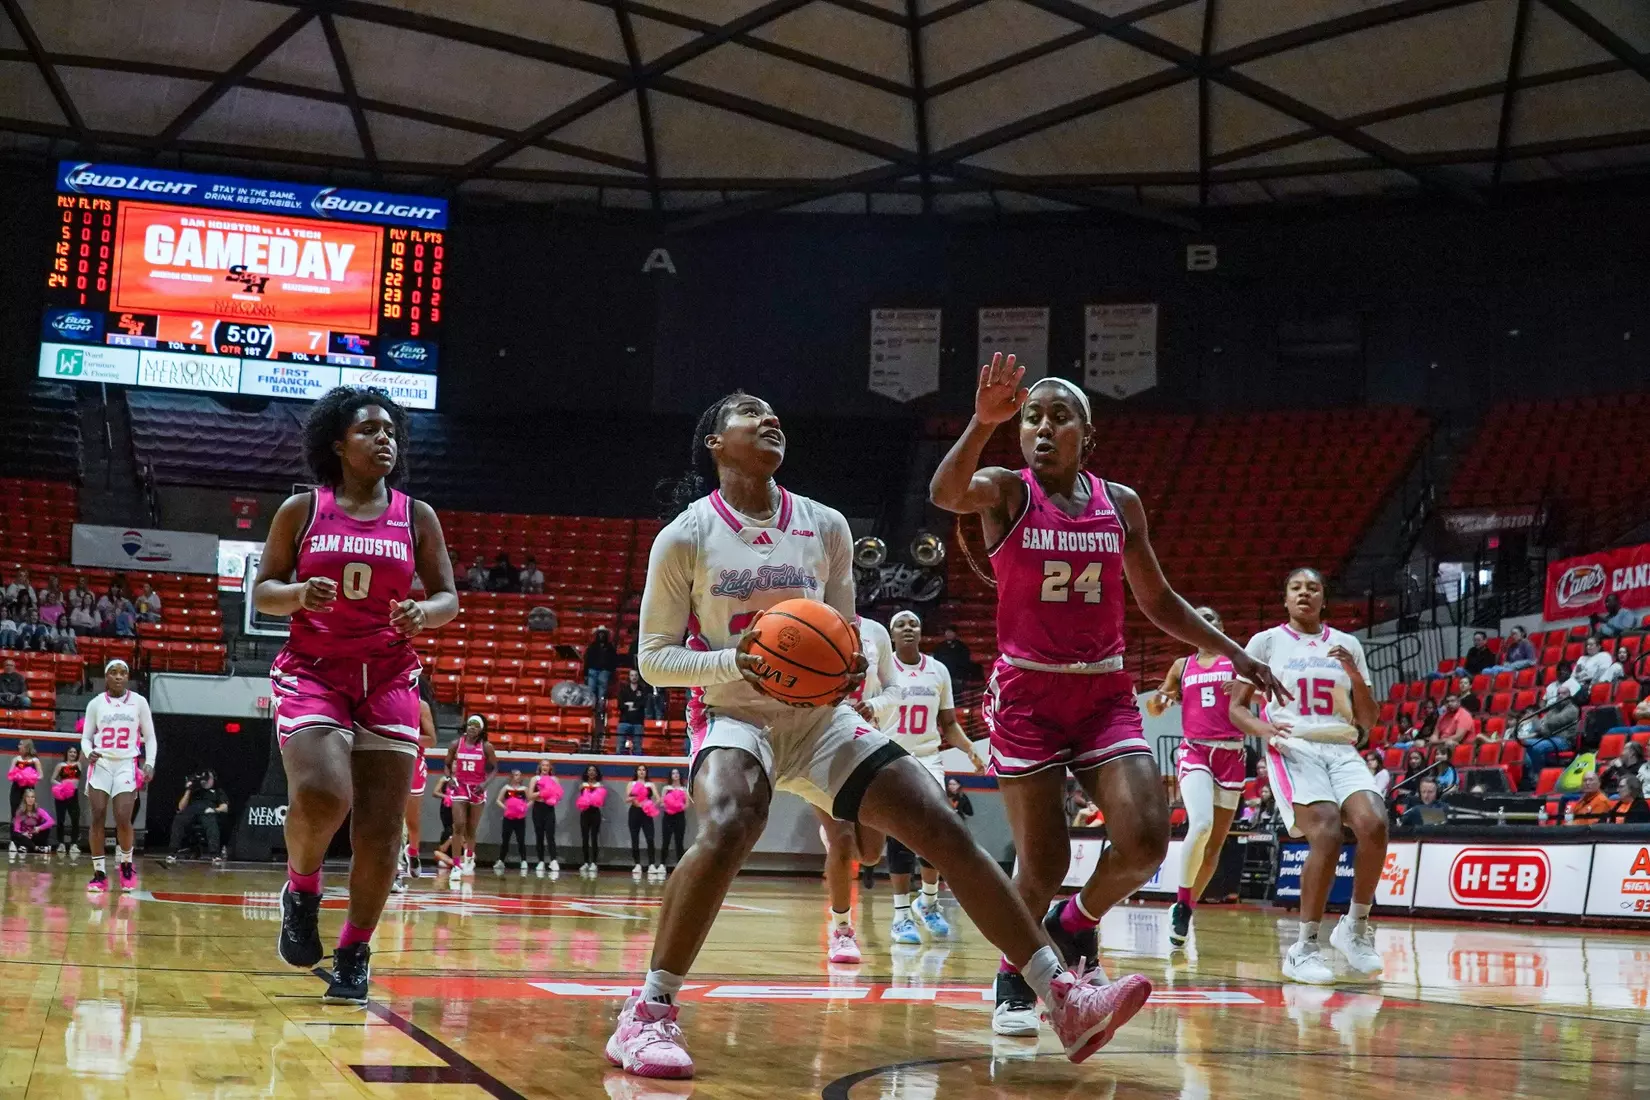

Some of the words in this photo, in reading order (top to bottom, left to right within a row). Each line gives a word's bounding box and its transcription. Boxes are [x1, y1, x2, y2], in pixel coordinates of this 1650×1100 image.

[75, 172, 127, 188] BUD
[126, 176, 197, 194] LIGHT
[204, 192, 234, 202] DRINK
[236, 195, 302, 208] RESPONSIBLY.
[213, 184, 236, 193] STAY
[250, 189, 268, 197] THE
[269, 190, 296, 200] GAME.
[58, 196, 75, 207] PLY
[79, 198, 90, 209] FL
[93, 199, 111, 211] PTS
[322, 196, 372, 213] BUD
[371, 201, 441, 219] LIGHT
[63, 211, 72, 223] 0
[83, 212, 92, 224] 0
[103, 214, 111, 226] 0
[81, 228, 90, 240] 0
[101, 230, 110, 242] 0
[208, 220, 260, 233] HOUSTON
[276, 227, 293, 237] LA
[293, 229, 321, 240] TECH
[390, 228, 407, 240] PLY
[410, 230, 422, 242] FL
[424, 232, 442, 244] PTS
[80, 244, 89, 257] 0
[100, 245, 109, 258] 0
[144, 224, 356, 282] GAMEDAY
[392, 242, 405, 255] 10
[415, 244, 424, 257] 0
[434, 246, 443, 259] 0
[1187, 245, 1217, 271] B
[55, 258, 68, 271] 15
[79, 260, 88, 273] 0
[98, 261, 108, 275] 2
[391, 258, 403, 271] 15
[414, 260, 423, 273] 0
[433, 262, 442, 274] 2
[641, 248, 676, 273] A
[48, 272, 67, 287] 24
[77, 275, 87, 289] 0
[97, 277, 106, 291] 0
[385, 272, 403, 286] 22
[432, 277, 441, 290] 0
[384, 287, 402, 302] 23
[412, 290, 421, 304] 0
[65, 316, 91, 325] BUD
[384, 303, 401, 318] 30
[411, 306, 420, 320] 0
[431, 308, 439, 322] 3
[58, 322, 94, 332] LIGHT
[190, 320, 204, 339] 2
[227, 325, 272, 345] 5:07
[308, 331, 323, 350] 7
[411, 322, 419, 336] 3
[168, 342, 185, 351] TOL
[220, 345, 241, 354] QTR
[244, 346, 261, 356] 1ST
[399, 346, 426, 354] BUD
[292, 352, 310, 361] TOL
[393, 351, 428, 361] LIGHT
[146, 357, 235, 377] MEMORIAL
[273, 367, 310, 377] FIRST
[144, 370, 235, 388] HERMANN
[257, 375, 323, 388] FINANCIAL
[359, 371, 418, 386] Charlie's
[272, 385, 307, 395] BANK
[310, 535, 339, 553] SAM
[342, 535, 408, 561] HOUSTON
[1022, 527, 1055, 550] SAM
[1057, 530, 1120, 553] HOUSTON
[343, 562, 372, 600] 0
[711, 568, 756, 600] Lady
[1040, 560, 1103, 603] 24
[1612, 562, 1650, 592] CAN
[1201, 686, 1216, 708] 5
[1297, 677, 1335, 716] 15
[897, 704, 928, 735] 10
[101, 727, 130, 749] 22
[462, 761, 476, 771] 12
